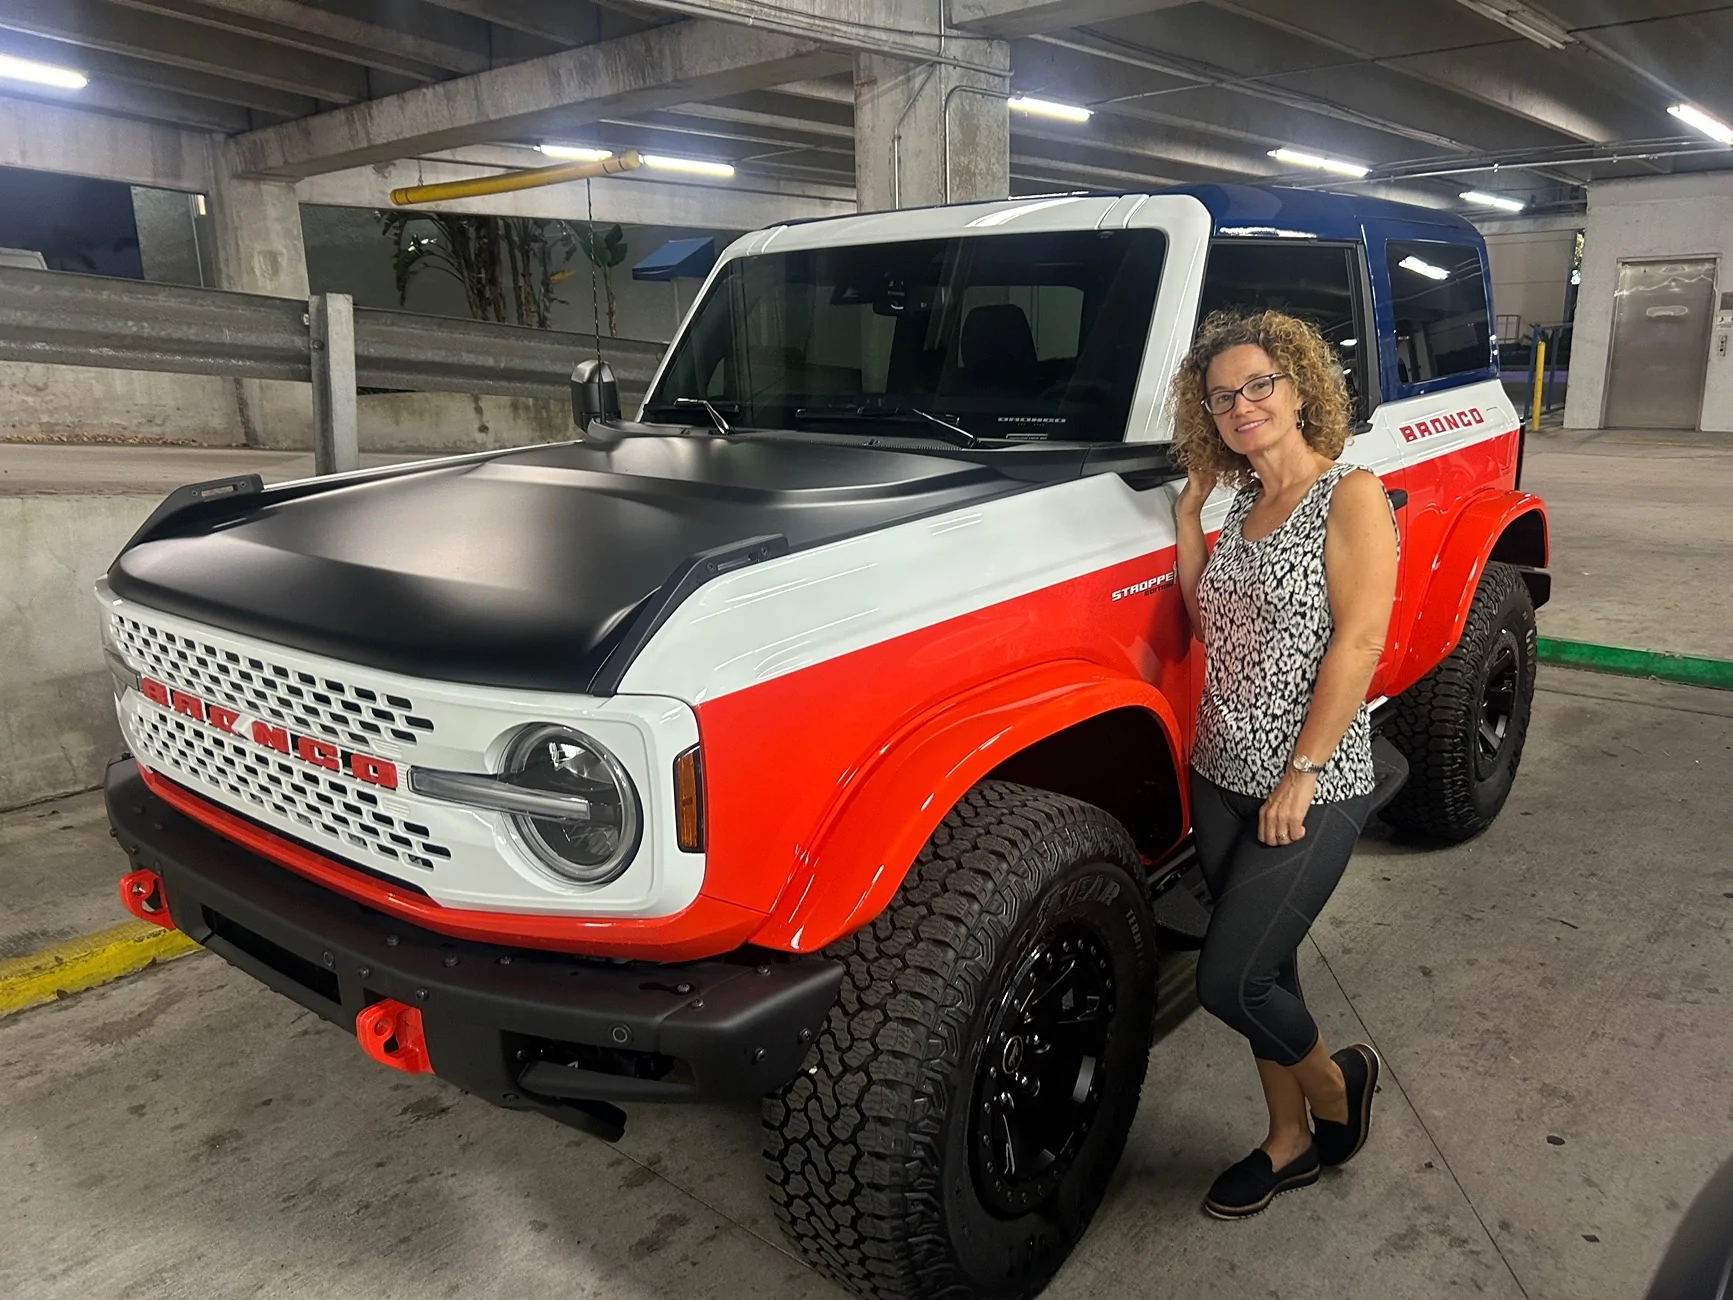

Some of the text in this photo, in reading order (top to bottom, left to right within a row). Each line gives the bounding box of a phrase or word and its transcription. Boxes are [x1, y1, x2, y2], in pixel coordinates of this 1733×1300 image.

[1399, 407, 1484, 443] BRONCO
[1111, 571, 1174, 602] STROPPE
[141, 676, 398, 789] BRONCO
